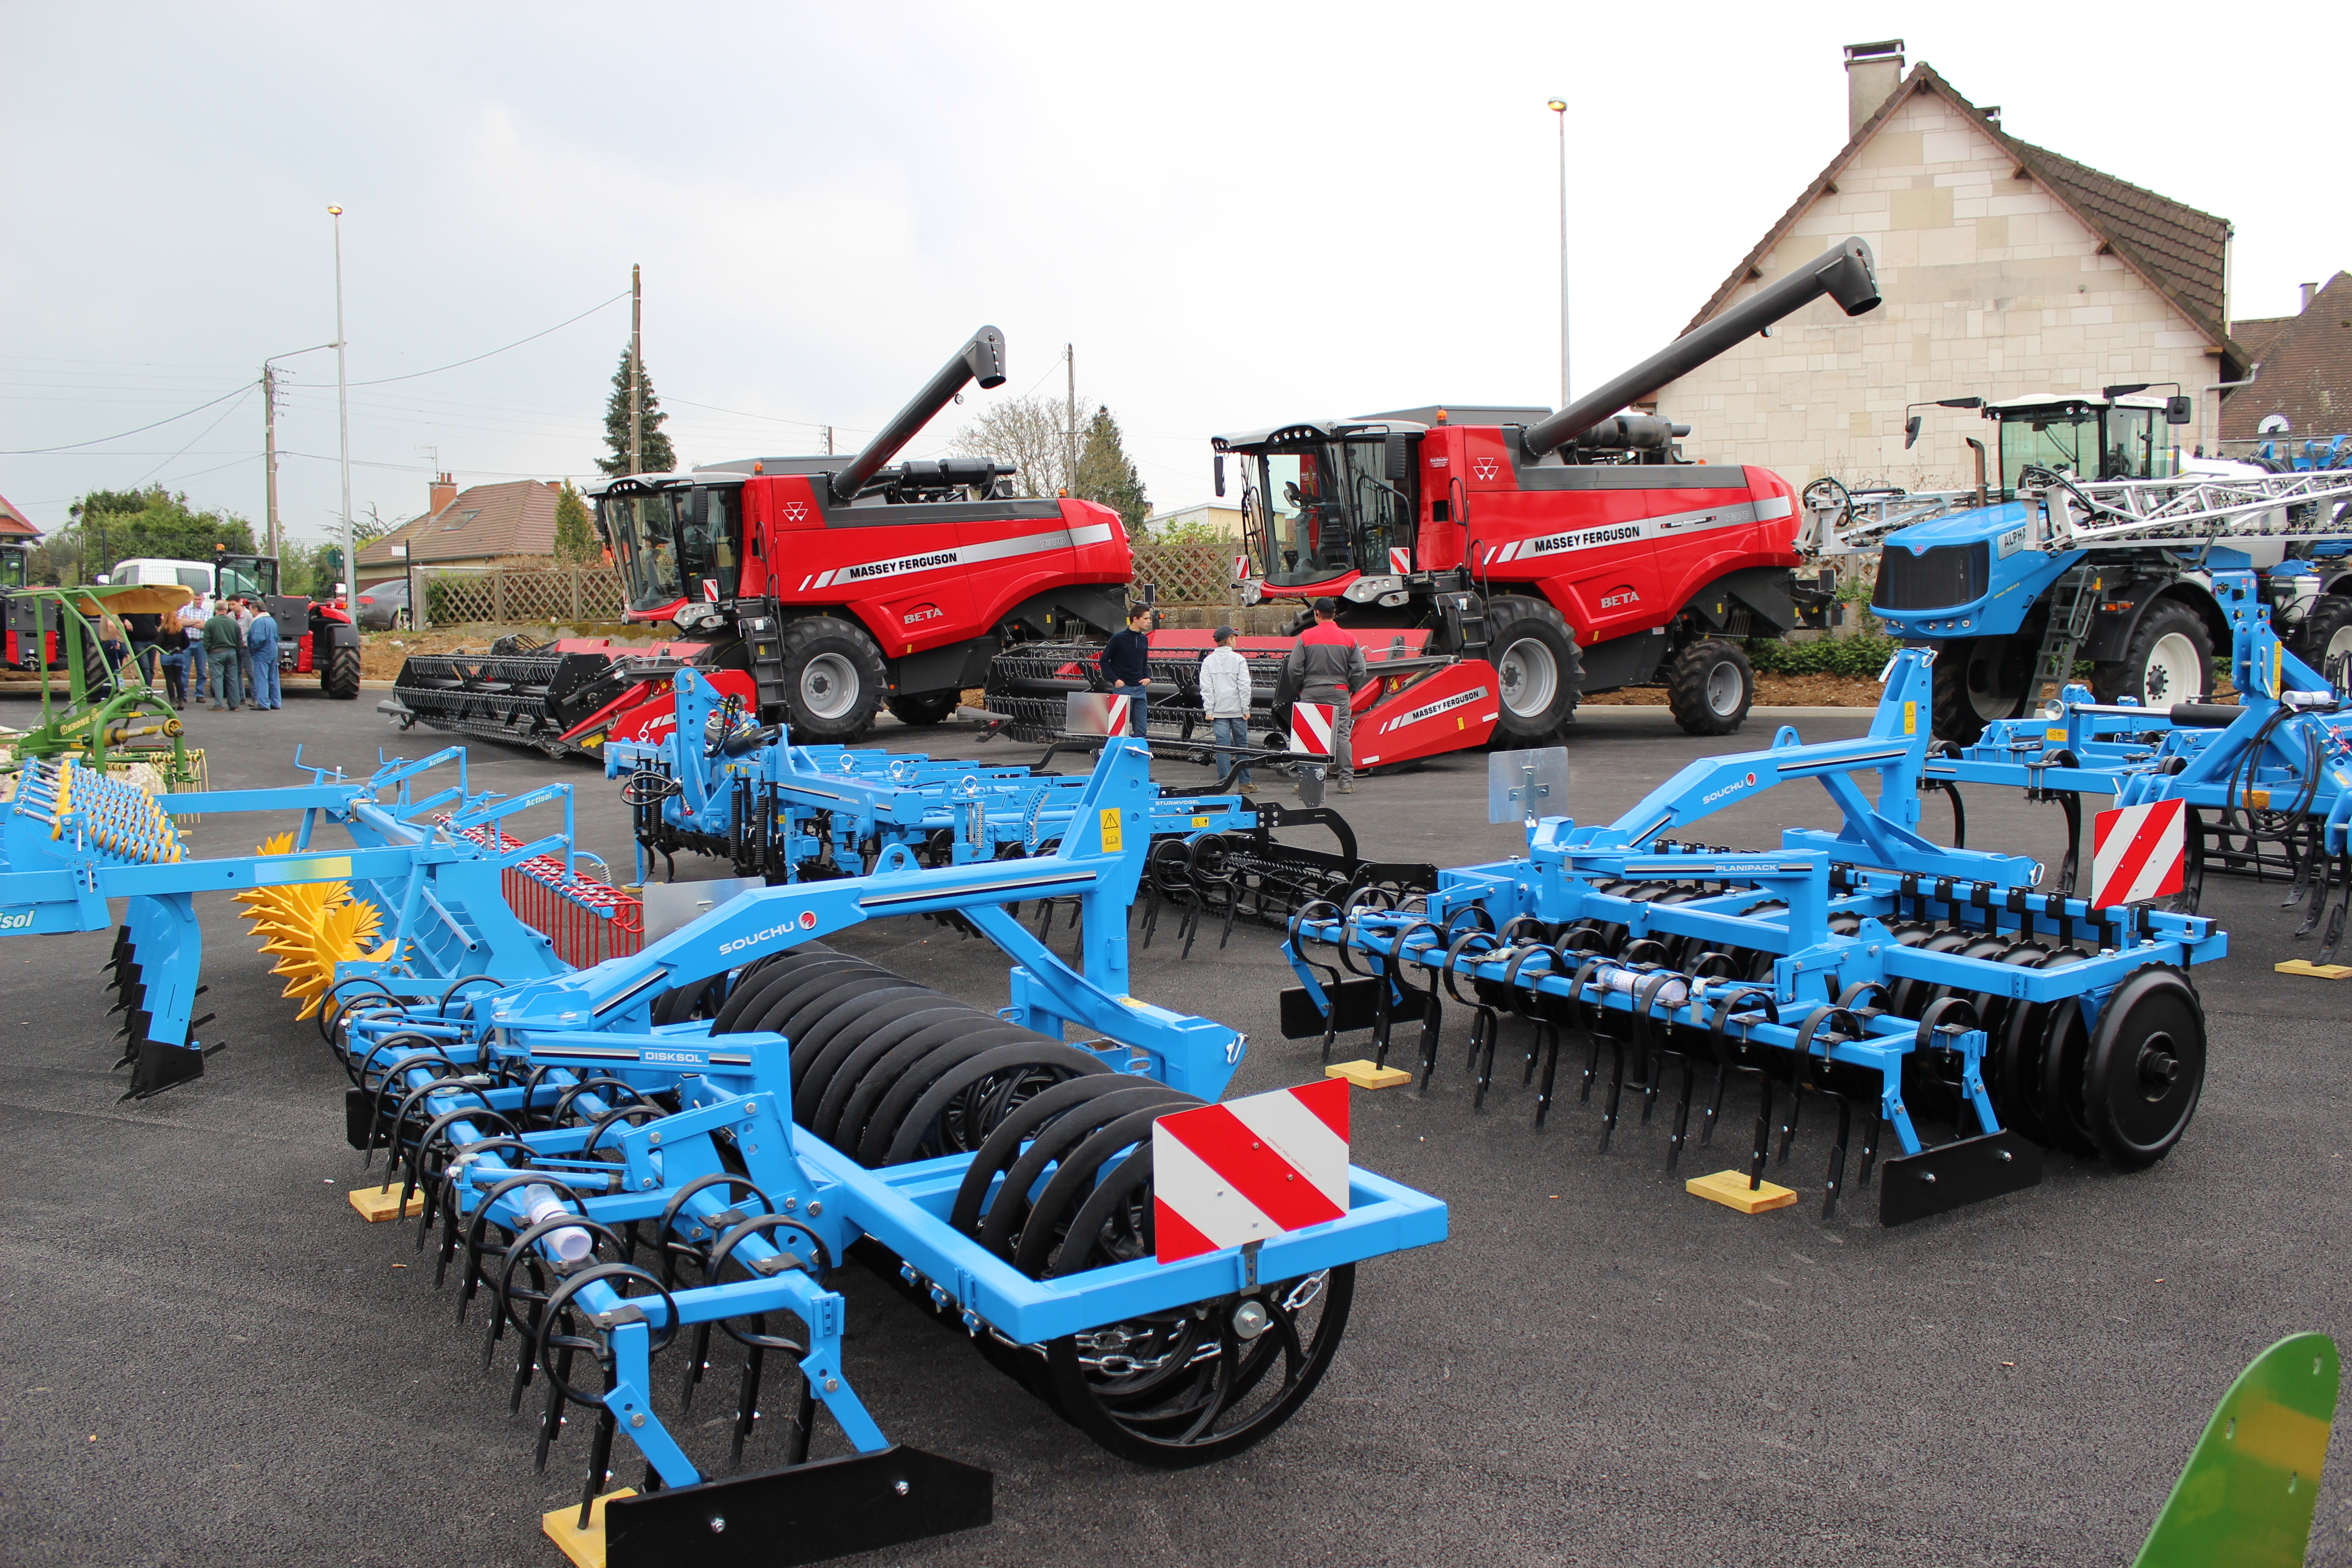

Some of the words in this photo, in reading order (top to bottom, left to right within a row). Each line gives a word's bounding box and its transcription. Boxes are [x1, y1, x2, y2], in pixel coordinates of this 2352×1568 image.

[1725, 511, 1749, 522] 7370
[1039, 537, 1065, 548] 7370
[1535, 534, 1580, 552] MASSEY
[1583, 525, 1640, 544] FERGUSON
[850, 562, 896, 578] MASSEY
[898, 553, 957, 570] FERGUSON
[1601, 591, 1640, 608] BETA
[903, 608, 944, 624] BETA
[1412, 704, 1441, 720] MASSEY
[1443, 691, 1479, 709] FERGUSON
[68, 715, 90, 733] KRONE
[429, 753, 450, 767] Actisol
[525, 791, 552, 808] Actisol
[1702, 779, 1744, 805] SOUCHU
[719, 921, 794, 956] SOUCHU
[645, 1052, 702, 1063] DISKSOL
